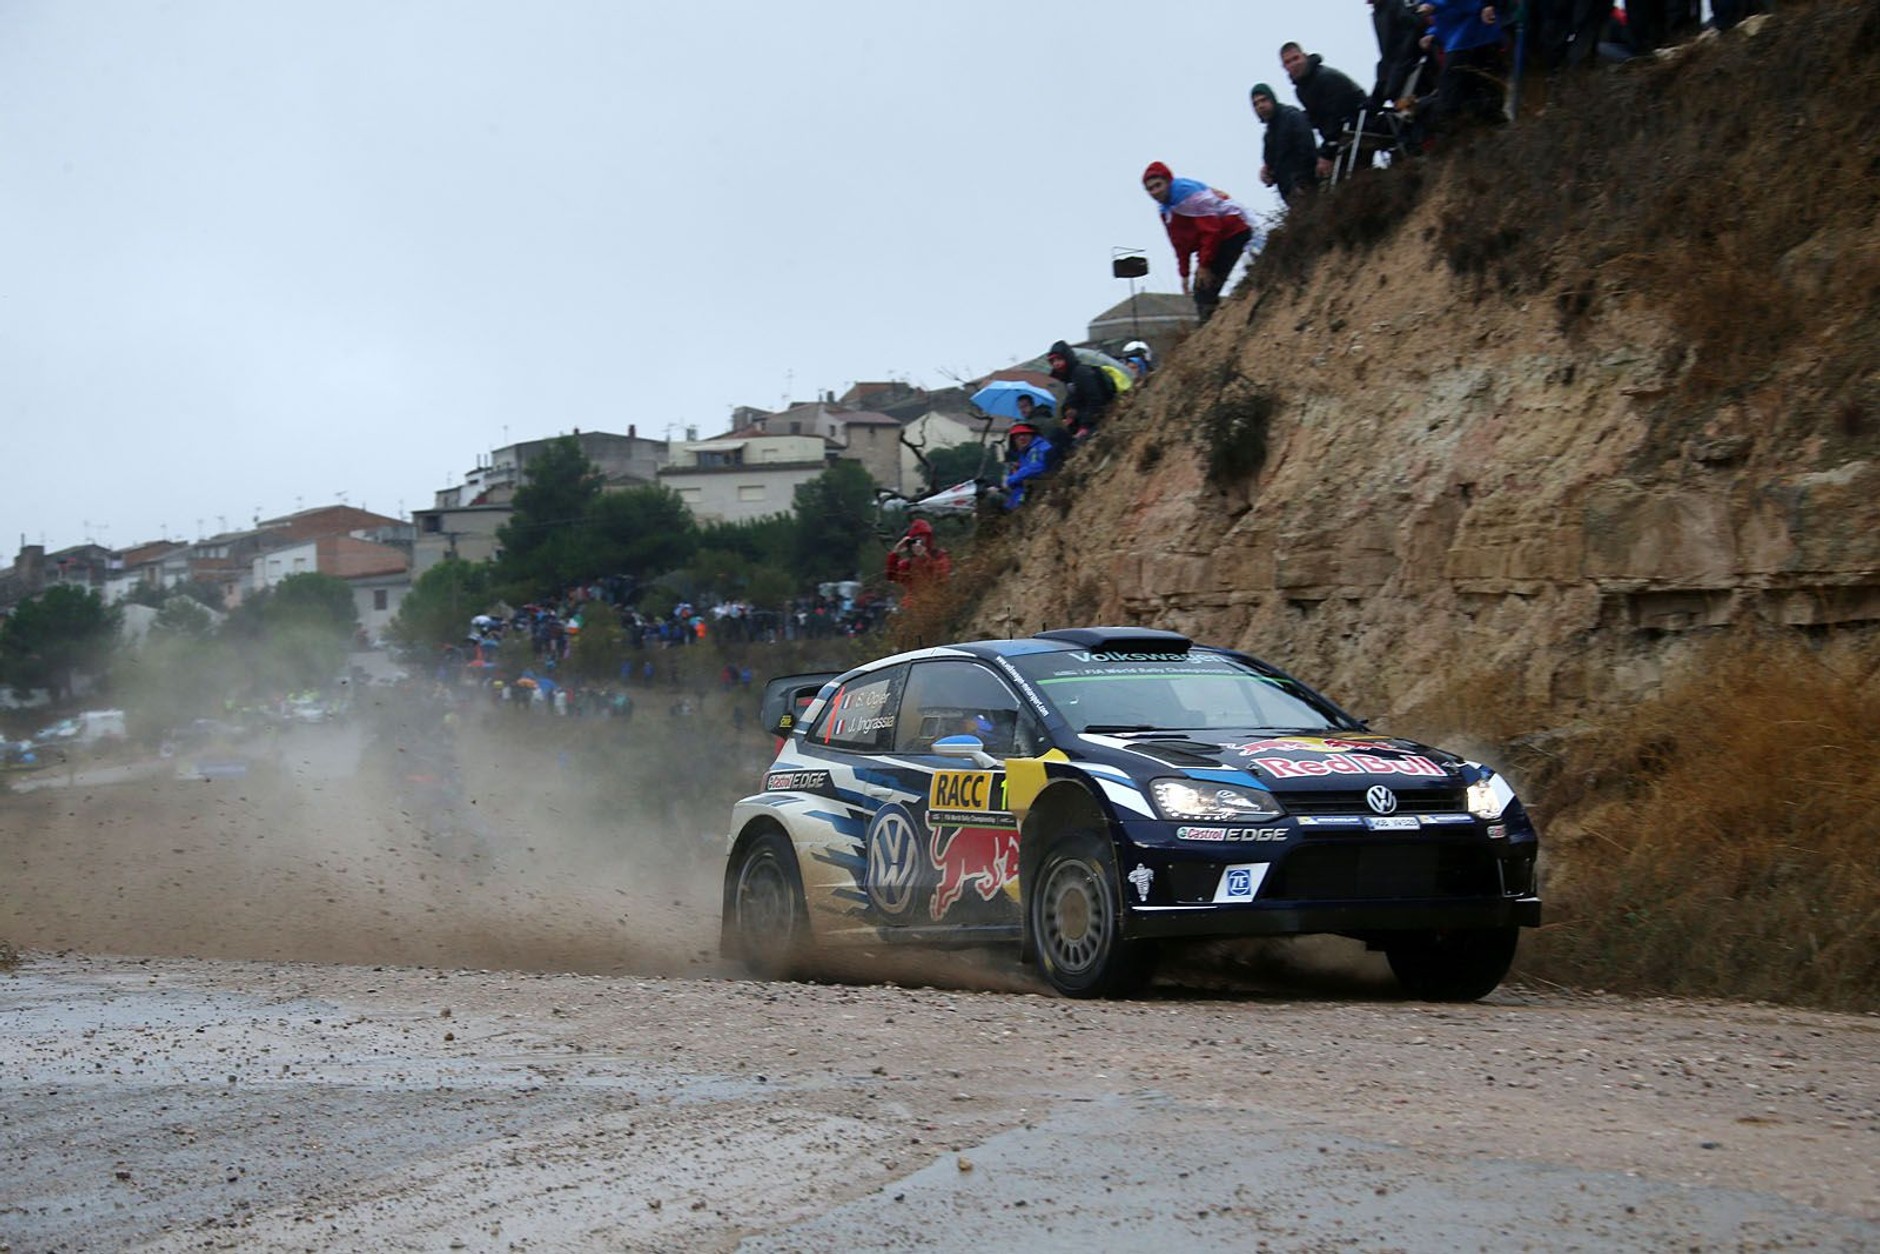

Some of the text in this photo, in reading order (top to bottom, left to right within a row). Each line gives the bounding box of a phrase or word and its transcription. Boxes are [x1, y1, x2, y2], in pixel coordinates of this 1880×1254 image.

[1067, 651, 1224, 664] Volkswagen
[866, 692, 891, 708] Ogier
[857, 714, 895, 734] Ingrassia
[1252, 754, 1448, 778] Red Bull
[791, 773, 828, 789] EDGE
[936, 775, 1008, 810] RACC 1
[1187, 827, 1290, 841] Castrol EDGE
